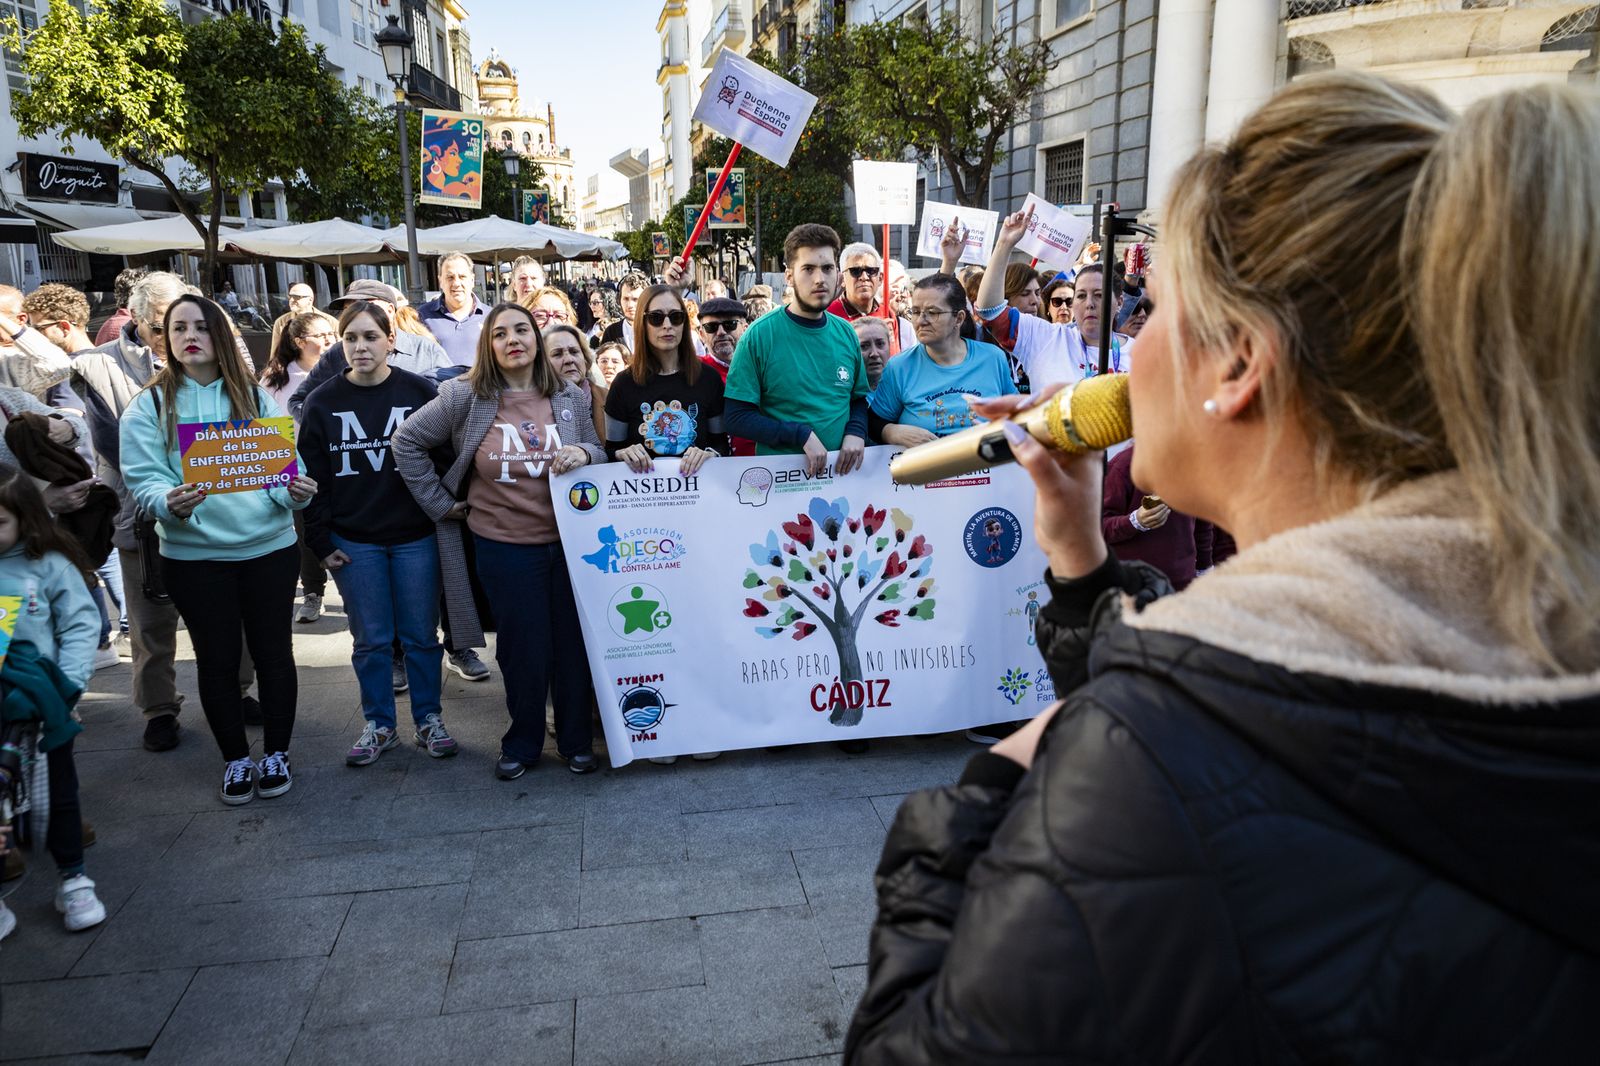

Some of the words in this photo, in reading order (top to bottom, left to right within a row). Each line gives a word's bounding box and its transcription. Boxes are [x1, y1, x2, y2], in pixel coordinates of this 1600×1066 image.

[744, 91, 791, 121] Duchenne
[753, 106, 788, 130] España
[461, 120, 481, 136] 30
[39, 161, 107, 195] Dieguito
[730, 173, 743, 184] 30
[1041, 222, 1075, 242] Duchenne
[1047, 233, 1072, 249] España
[195, 428, 219, 441] DÍA
[222, 425, 281, 439] MUNDIAL
[223, 442, 238, 452] de
[241, 441, 258, 450] las
[329, 443, 339, 452] La
[372, 438, 382, 448] de
[189, 448, 292, 467] ENFERMEDADES
[488, 452, 498, 460] La
[494, 423, 563, 483] M
[220, 464, 266, 477] RARAS:
[196, 481, 213, 491] 29
[216, 479, 232, 489] de
[235, 472, 291, 487] FEBRERO
[608, 475, 700, 496] ANSEDH
[926, 478, 988, 488] desafioduchenne.org
[608, 496, 641, 504] ASOCIACIÓN
[975, 510, 1005, 524] AVENTURA
[1005, 514, 1014, 523] DE
[969, 522, 976, 531] LA
[1011, 521, 1019, 531] UN
[623, 527, 683, 541] ASOCIACIÓN
[619, 538, 675, 557] DIEGO
[1011, 531, 1021, 553] X-MEN
[621, 563, 652, 573] CONTRA
[653, 562, 664, 571] LA
[665, 561, 681, 569] AME
[604, 651, 643, 660] PRADER-WILLI
[643, 648, 676, 657] ANDALUCÍA
[606, 644, 642, 653] ASOCIACIÓN
[642, 642, 673, 650] SÍNDROME
[741, 658, 789, 684] RARAS
[797, 653, 830, 678] PERO
[866, 650, 884, 673] NO
[894, 644, 976, 671] INVISIBLES
[810, 676, 892, 712] CÁDIZ
[631, 732, 658, 743] IVAN
